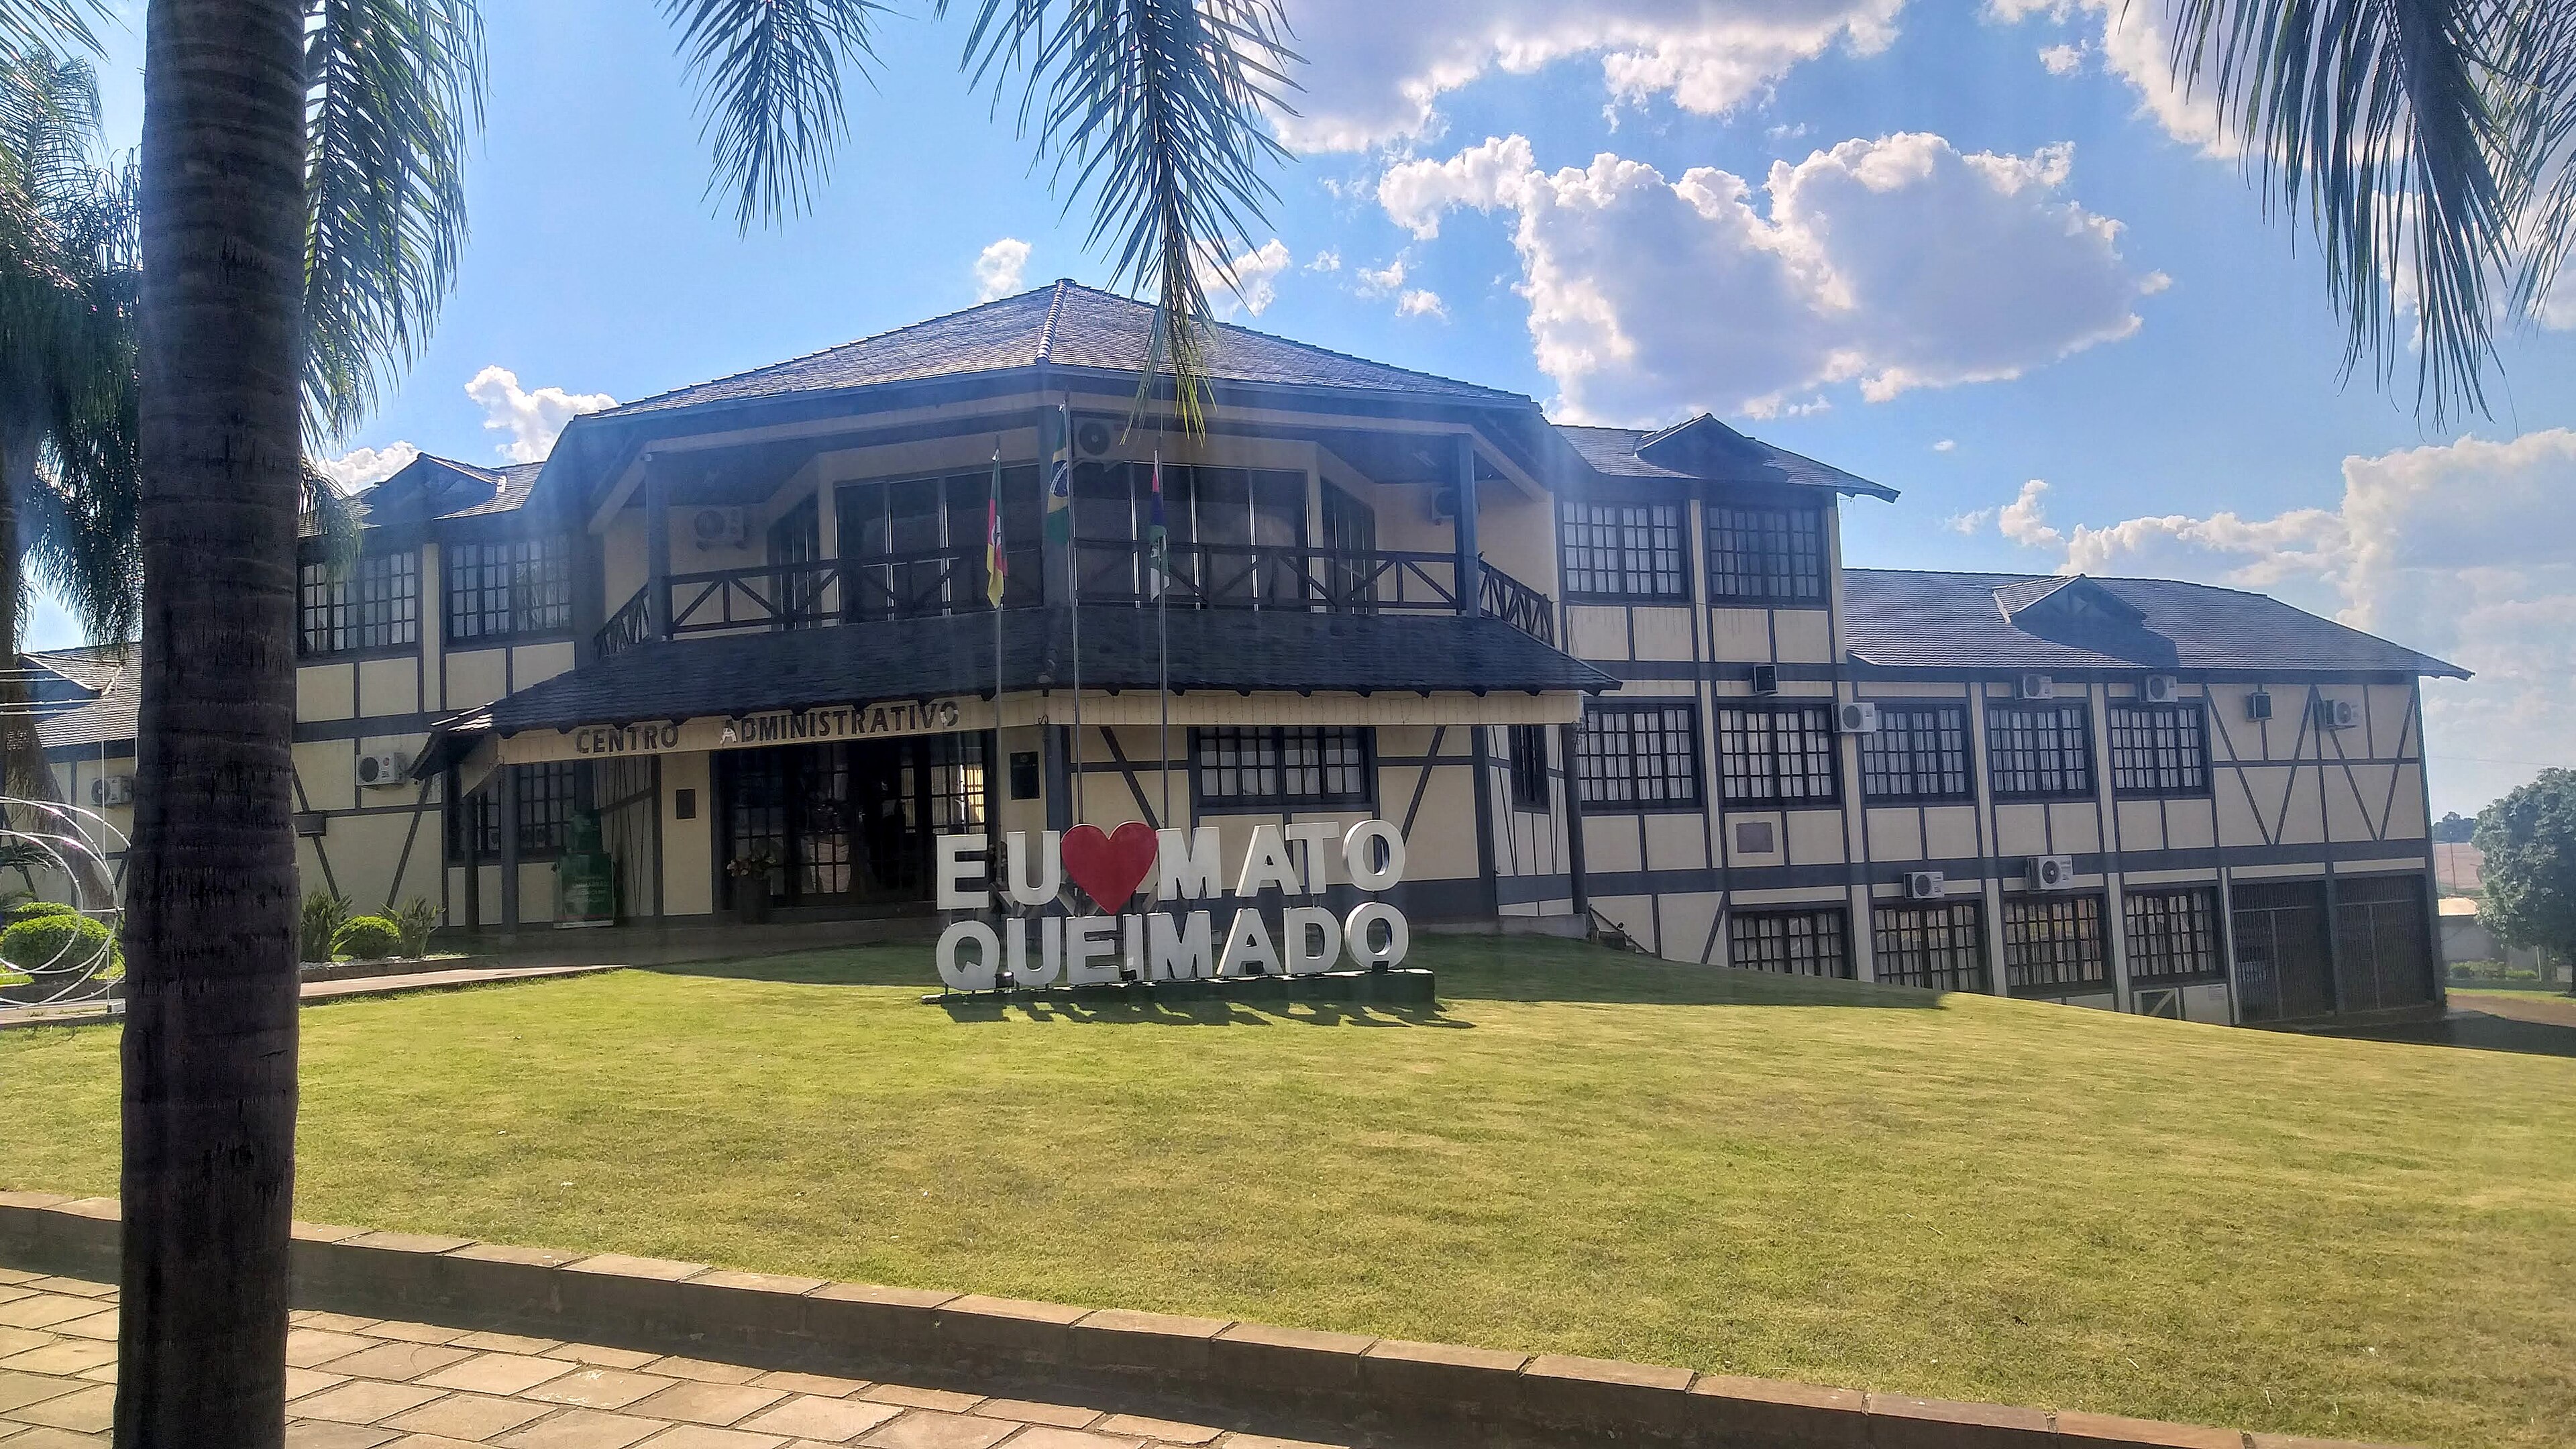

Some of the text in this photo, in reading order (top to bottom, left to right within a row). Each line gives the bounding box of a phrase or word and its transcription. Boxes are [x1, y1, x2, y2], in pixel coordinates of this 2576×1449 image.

[575, 700, 959, 754] CENTRO ADMINISTRATIVO
[936, 820, 1406, 910] EU MATO
[936, 902, 1409, 991] QUEIMADO
